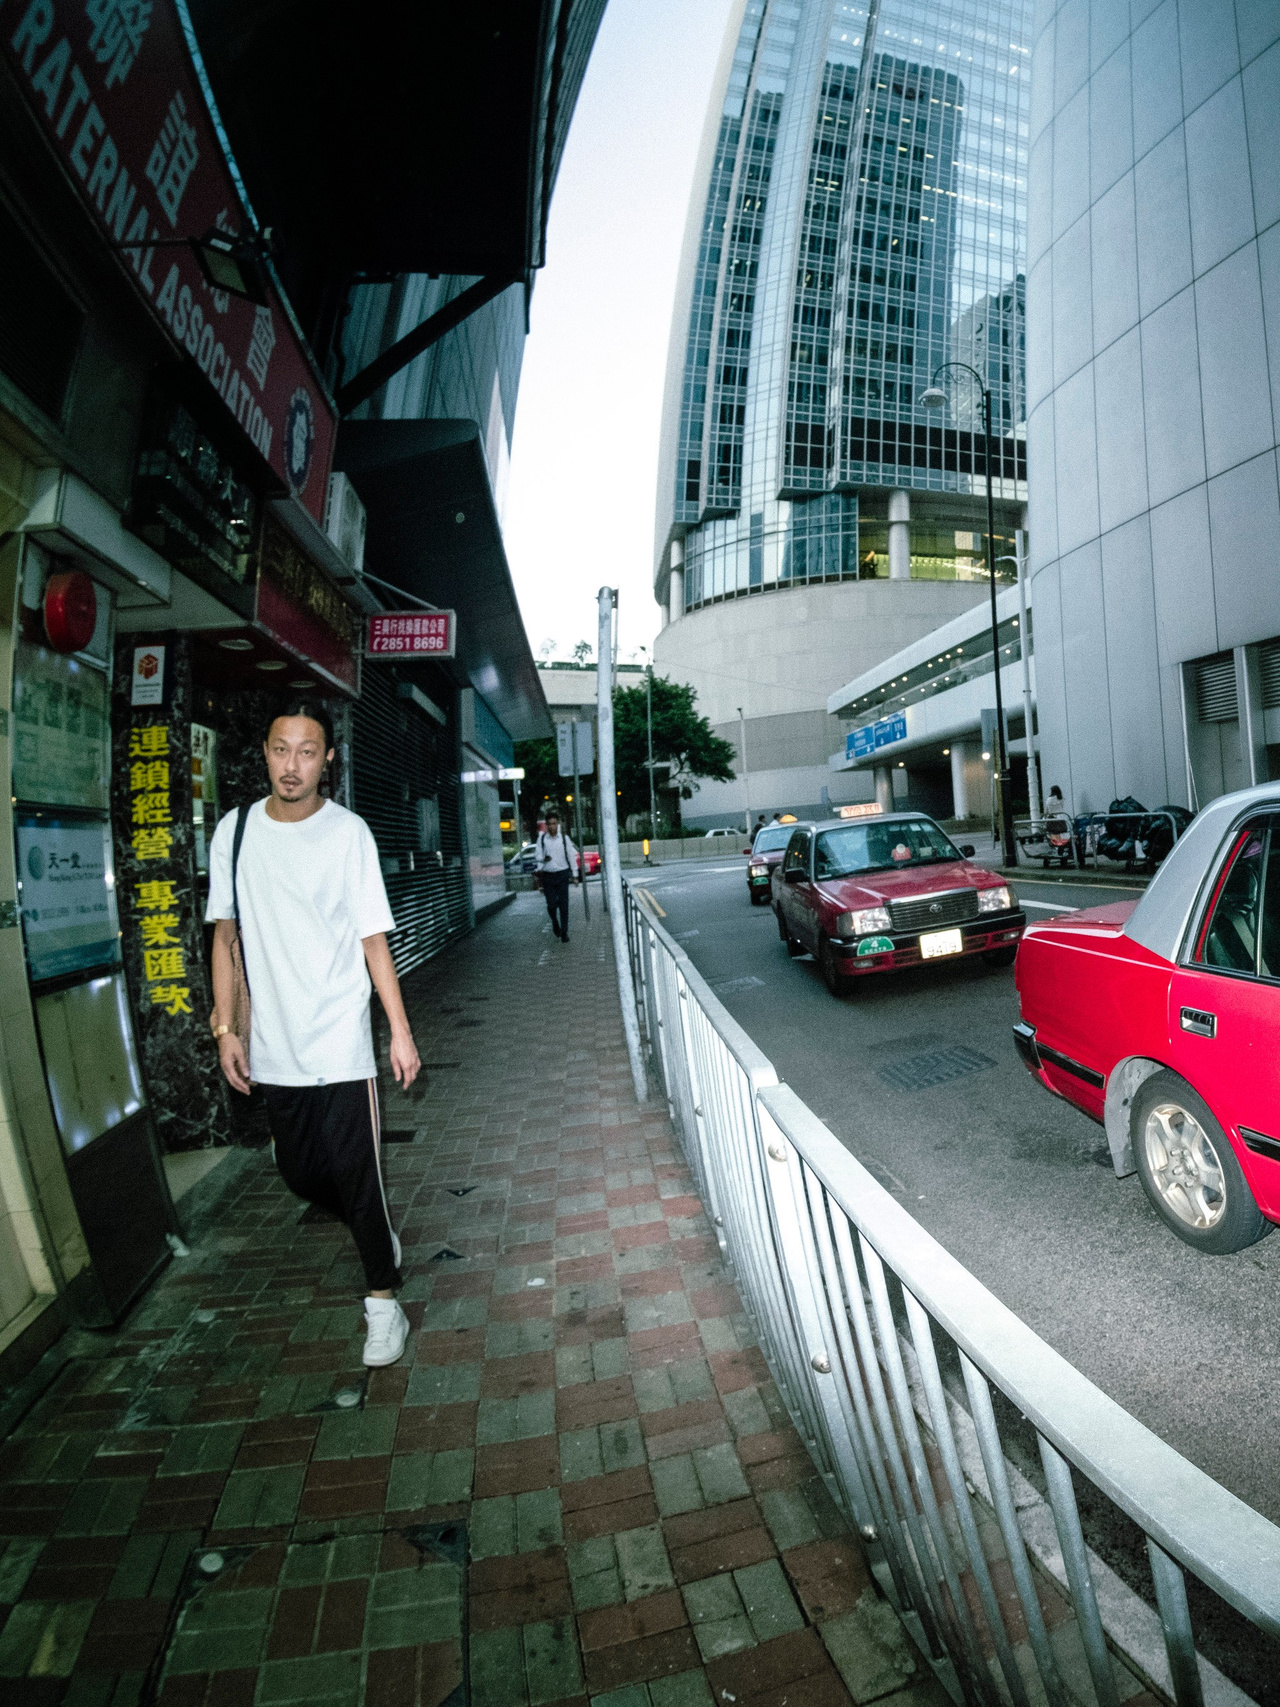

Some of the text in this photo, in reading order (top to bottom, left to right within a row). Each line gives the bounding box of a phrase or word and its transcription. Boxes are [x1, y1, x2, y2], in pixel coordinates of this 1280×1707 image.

[0, 0, 154, 296] RATERNAL
[155, 264, 273, 461] ASSOCIATION
[85, 0, 277, 391] 聯誼會
[381, 636, 443, 650] 2851 8696
[129, 725, 173, 861] 連鎖經營
[843, 803, 880, 816] TAXI
[134, 880, 194, 1016] 專業匯款
[864, 946, 887, 955] SEATS
[871, 940, 879, 948] 4
